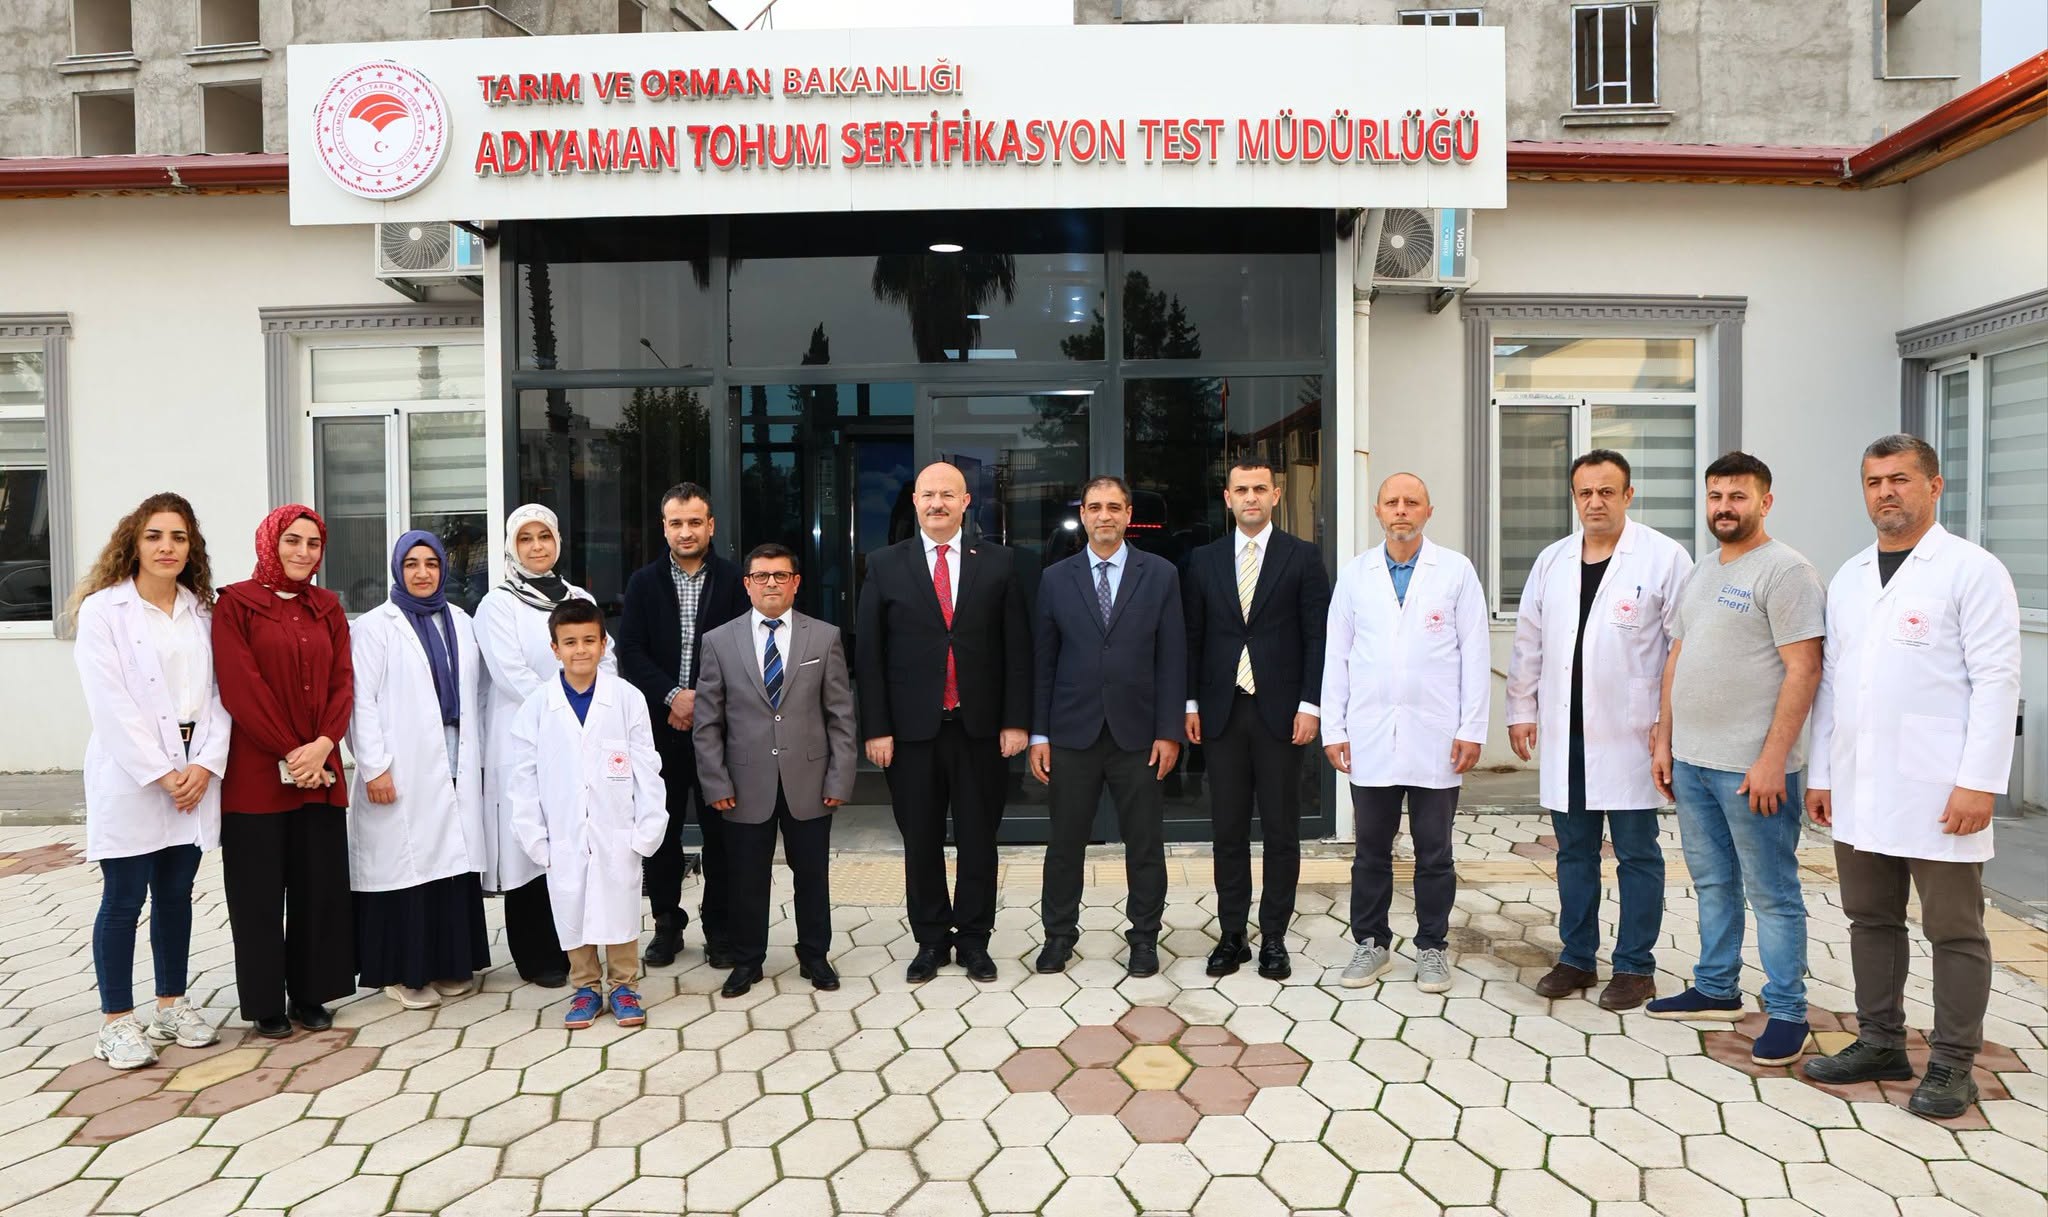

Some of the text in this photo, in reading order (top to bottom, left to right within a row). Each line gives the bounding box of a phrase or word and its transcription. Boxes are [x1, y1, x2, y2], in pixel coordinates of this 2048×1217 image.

[477, 57, 963, 103] TARIM VE ORMAN BAKANLIĞI
[474, 107, 1480, 174] ADIYAMAN TOHUM SERTİFİKASYON TEST MÜDÜRLÜĞÜ
[1456, 227, 1465, 257] SIGMA
[1717, 596, 1750, 614] Enerji
[1721, 583, 1752, 600] Elmak
